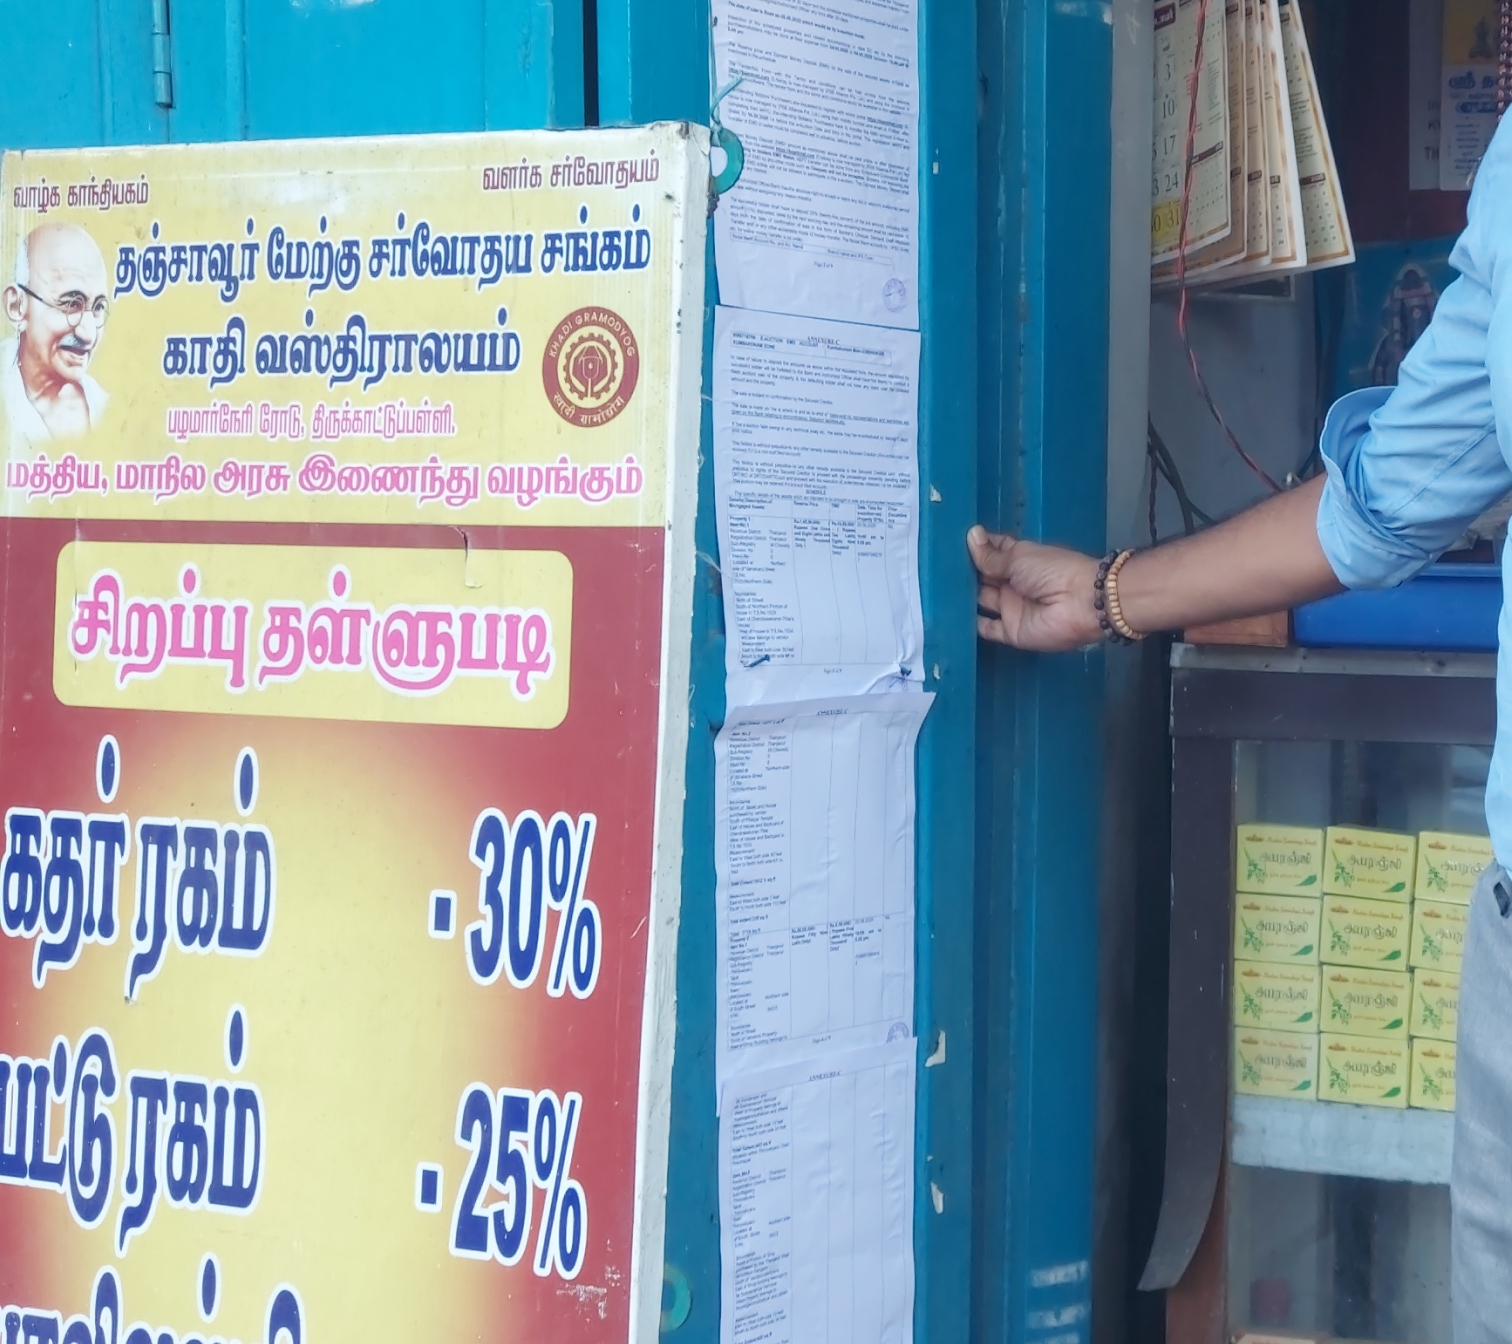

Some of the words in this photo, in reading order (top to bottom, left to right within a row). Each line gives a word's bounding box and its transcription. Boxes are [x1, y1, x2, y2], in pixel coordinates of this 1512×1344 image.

[13, 179, 61, 213] வாழ்க
[67, 174, 149, 210] காந்தியகம்
[482, 158, 542, 190] வளர்க
[550, 149, 659, 189] சர்வோதயம்
[114, 219, 260, 302] தஞ்சாவூர்
[267, 216, 361, 295] மேற்கு
[368, 212, 533, 290] சர்வோதய
[540, 204, 651, 274] சங்கம்
[163, 316, 246, 388] காதி
[255, 307, 520, 390] வஸ்திராலயம்
[548, 321, 573, 358] KHADI
[575, 311, 635, 357] GRAMODYOG
[6, 455, 108, 499] மத்திய,
[116, 455, 206, 501] மாநில
[213, 460, 290, 497] அரசு
[298, 454, 480, 507] இணைந்து
[487, 456, 643, 507] வழங்கும்
[72, 568, 247, 688] சிறப்பு
[258, 570, 551, 696] தள்ளுபடி
[2, 741, 126, 982] கதர்
[129, 753, 271, 997] ரகம்
[0, 1033, 116, 1224] பட்டு
[119, 1010, 261, 1252] ரகம்
